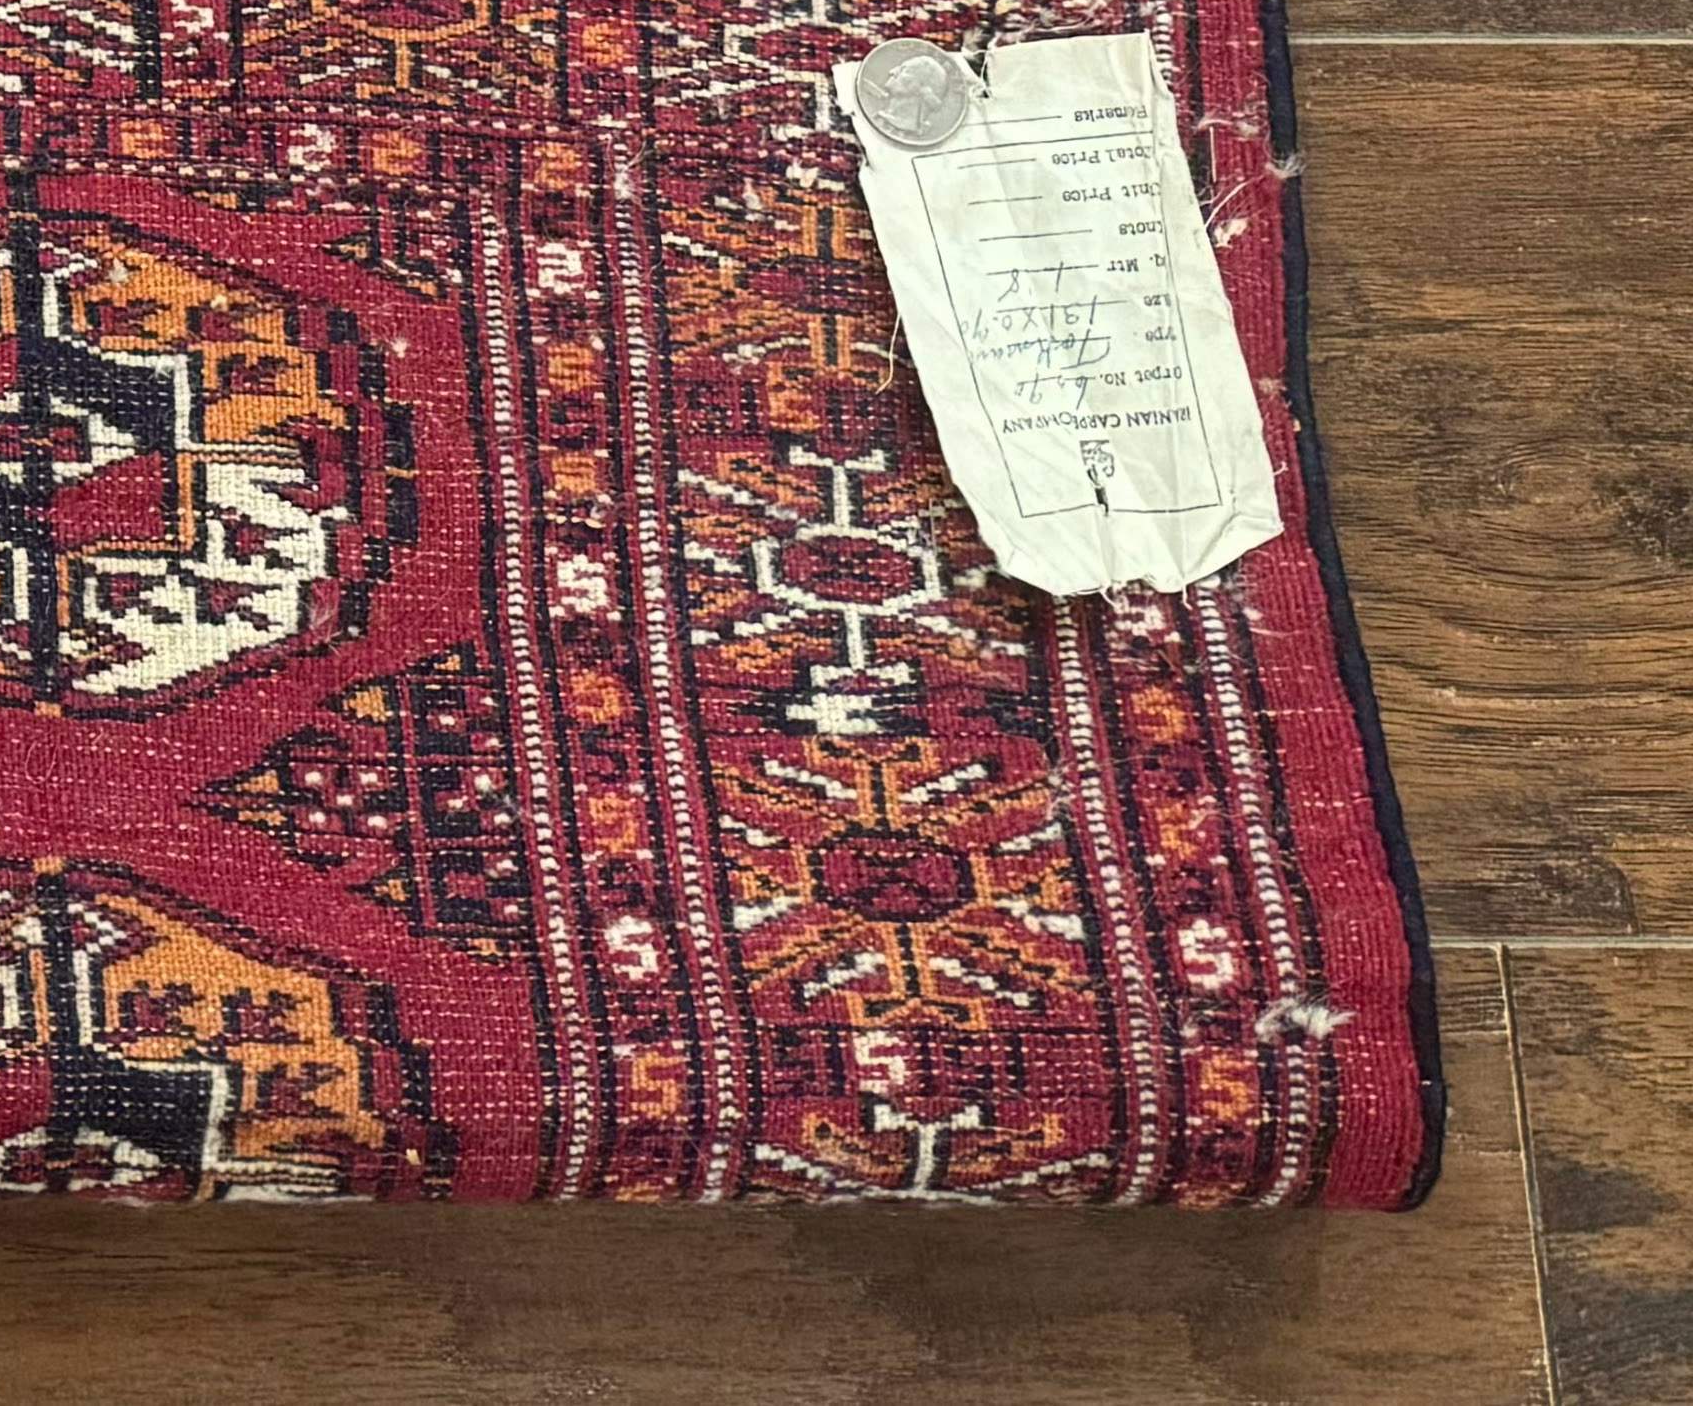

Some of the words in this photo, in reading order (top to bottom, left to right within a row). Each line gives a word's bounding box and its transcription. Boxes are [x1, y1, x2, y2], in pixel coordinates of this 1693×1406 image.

[1051, 151, 1101, 166] Price
[1062, 187, 1111, 202] Price
[1107, 258, 1139, 272] Mtr
[1099, 371, 1126, 387] No.
